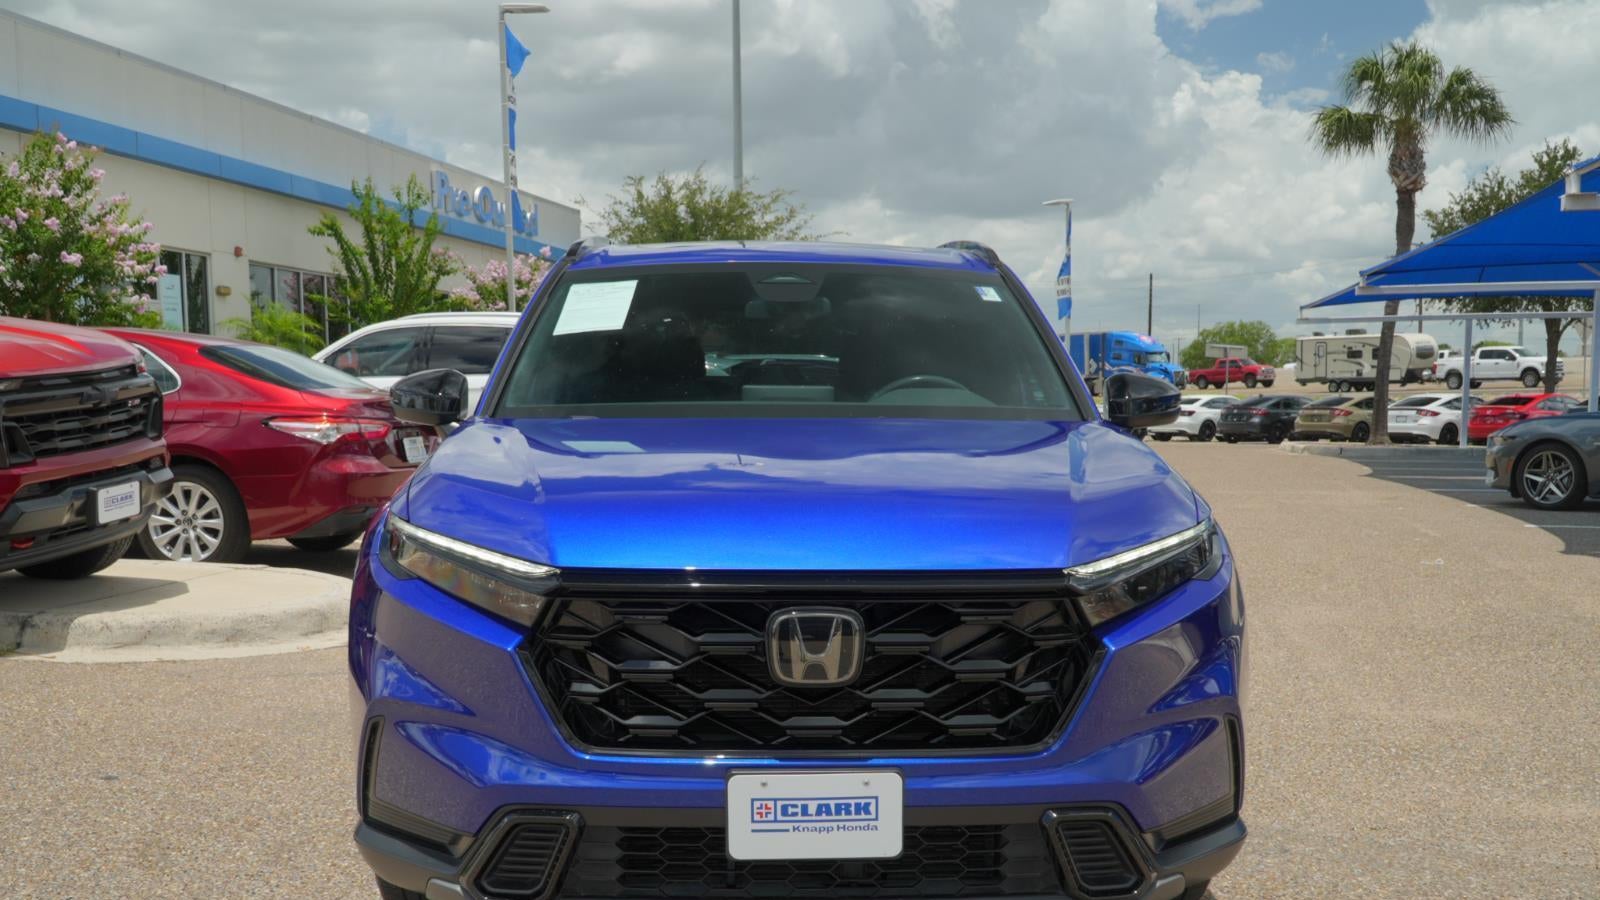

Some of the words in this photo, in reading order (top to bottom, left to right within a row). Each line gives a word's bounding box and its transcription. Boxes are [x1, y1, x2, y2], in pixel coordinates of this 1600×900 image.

[780, 802, 872, 817] CLARK
[792, 825, 834, 834] Knapp
[836, 823, 878, 832] Honda
